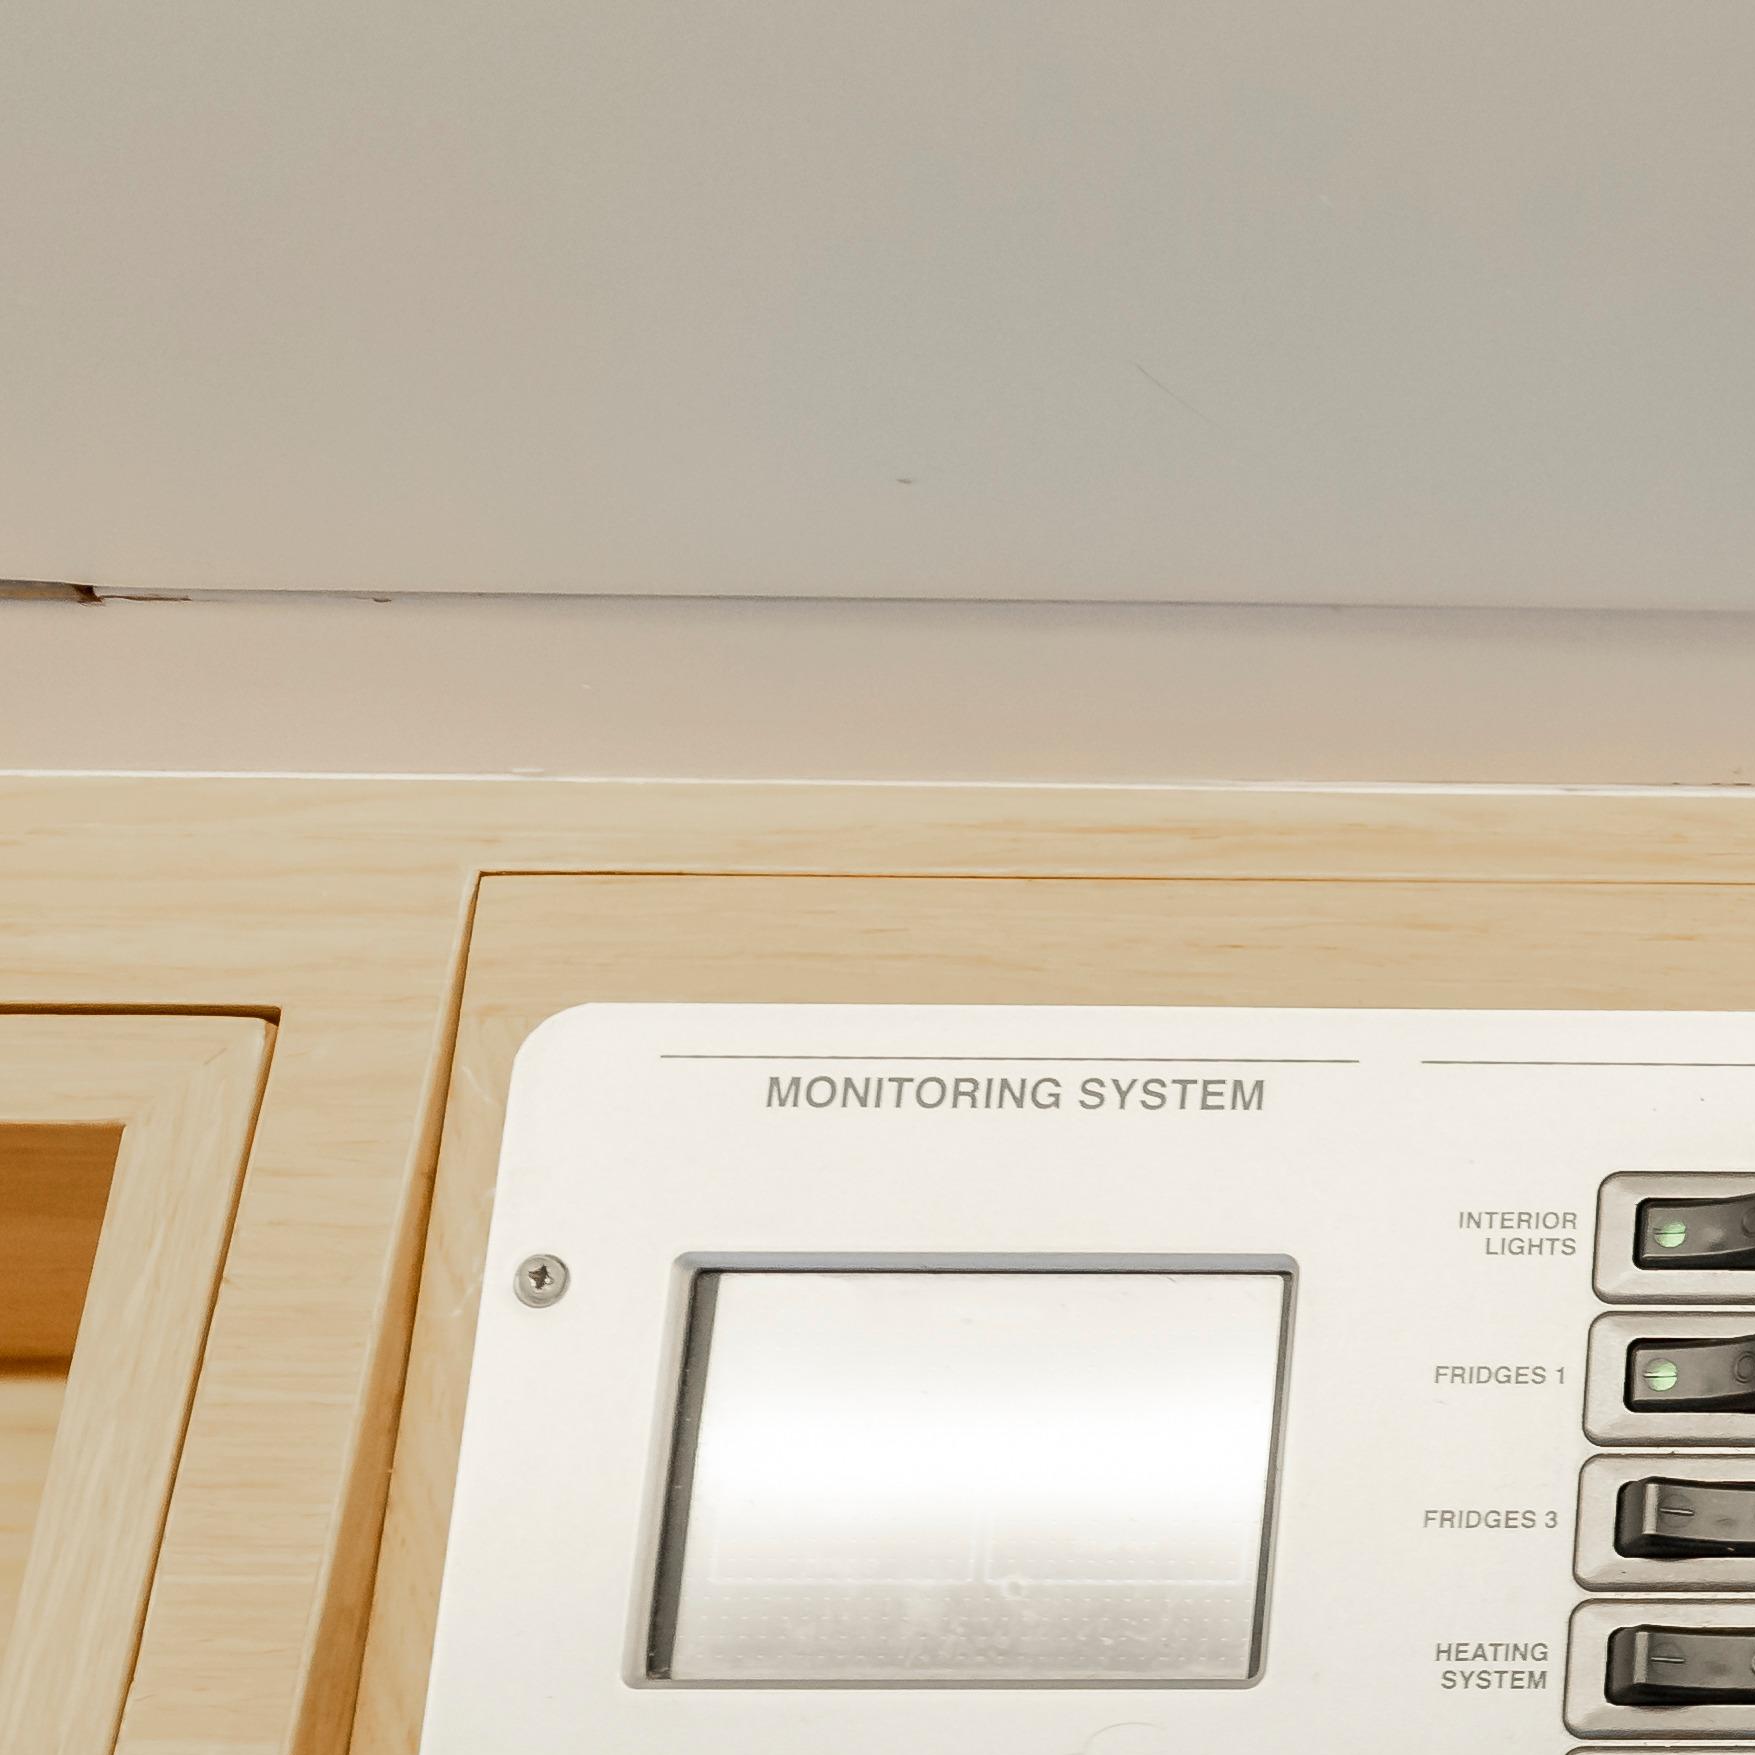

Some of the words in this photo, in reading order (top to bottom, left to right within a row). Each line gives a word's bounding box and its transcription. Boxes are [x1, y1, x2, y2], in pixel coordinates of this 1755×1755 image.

[766, 1075, 1062, 1110] MONITORING
[1078, 1077, 1265, 1111] SYSTEM
[1459, 1211, 1577, 1230] INTERIOR
[1485, 1237, 1577, 1256] LIGHTS
[1434, 1365, 1547, 1385] FRIDGES
[1555, 1366, 1565, 1385] 1
[1423, 1509, 1537, 1529] FRIDGES
[1544, 1510, 1559, 1529] 3
[1435, 1642, 1548, 1662] HEATING
[1440, 1669, 1548, 1690] SYSTEM
